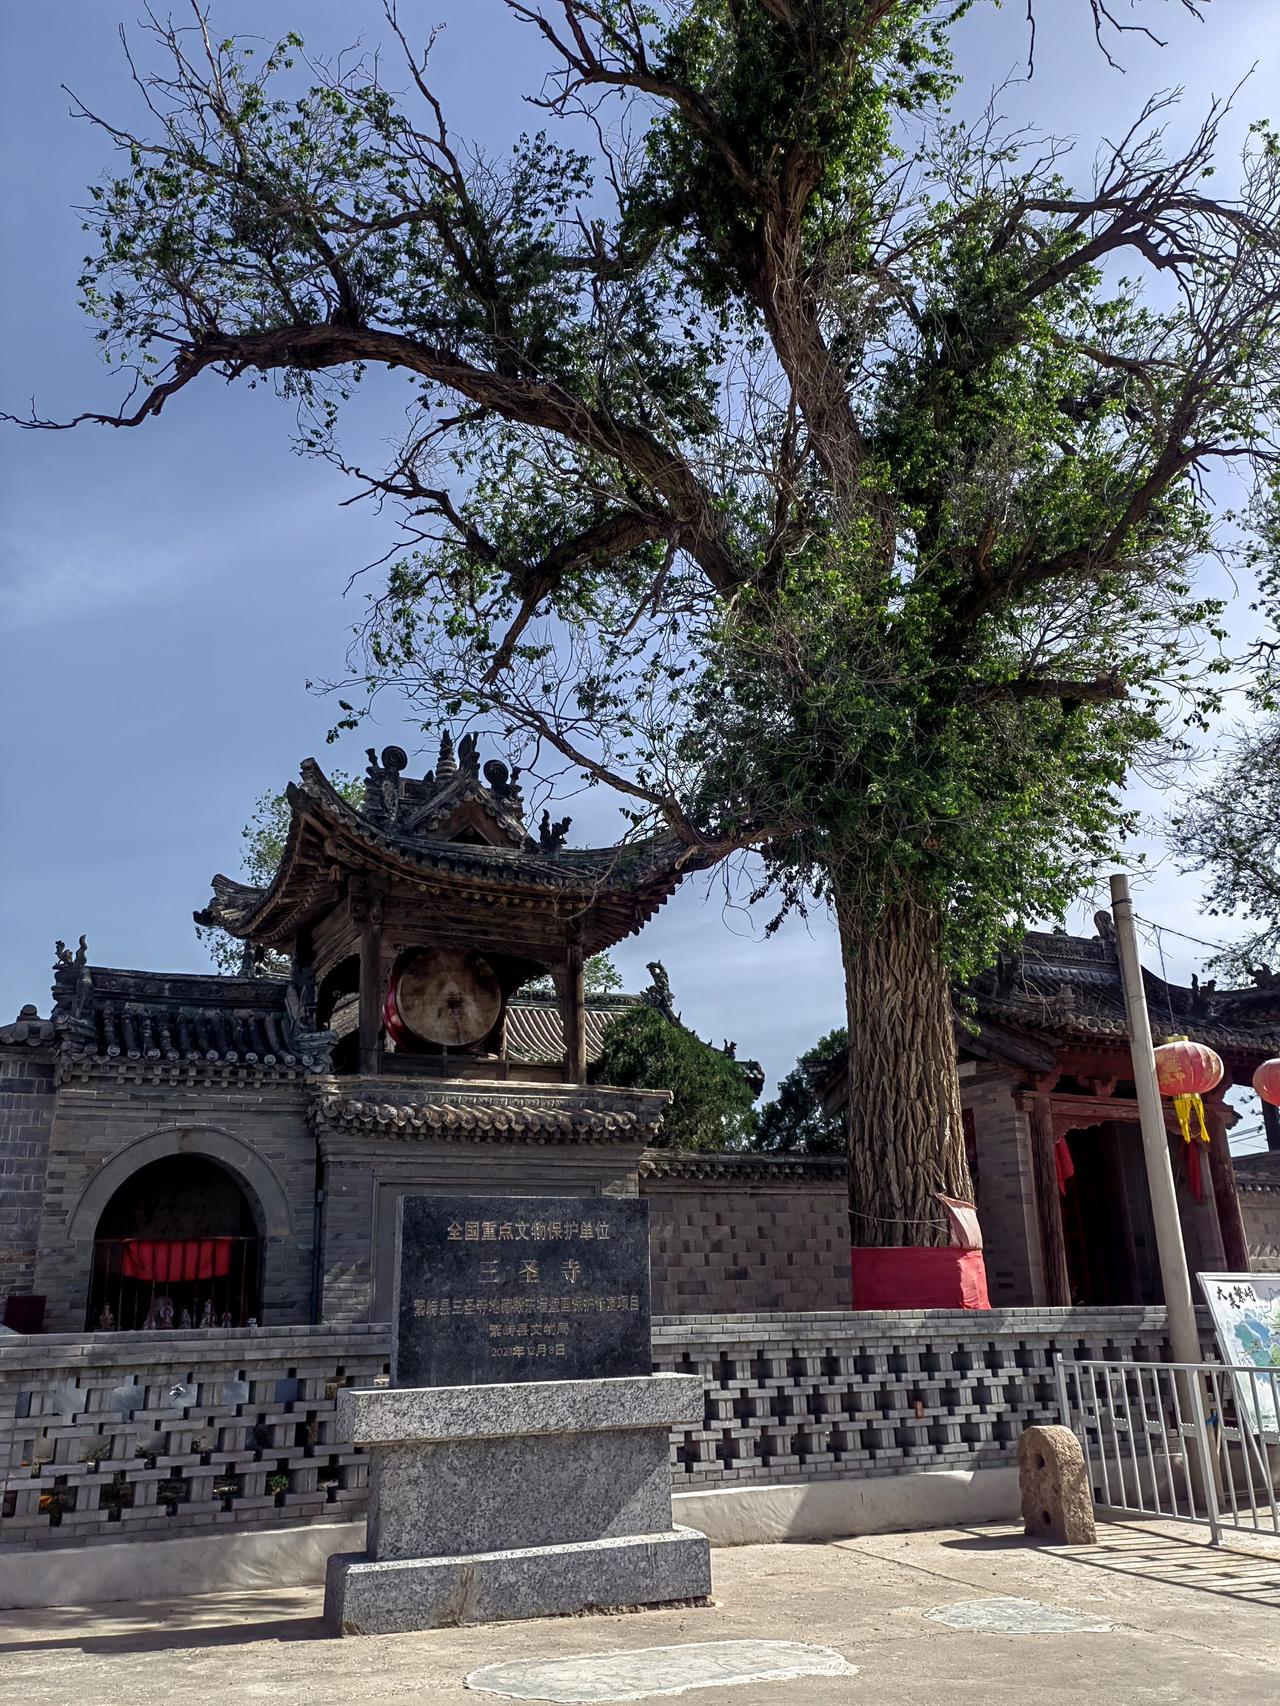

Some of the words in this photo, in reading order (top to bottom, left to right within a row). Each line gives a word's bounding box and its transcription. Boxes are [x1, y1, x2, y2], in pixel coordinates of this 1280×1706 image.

[447, 1220, 611, 1241] 全国重点文物保护单位
[478, 1258, 582, 1284] 三圣寺
[489, 1322, 570, 1338] 繁峙县文物局
